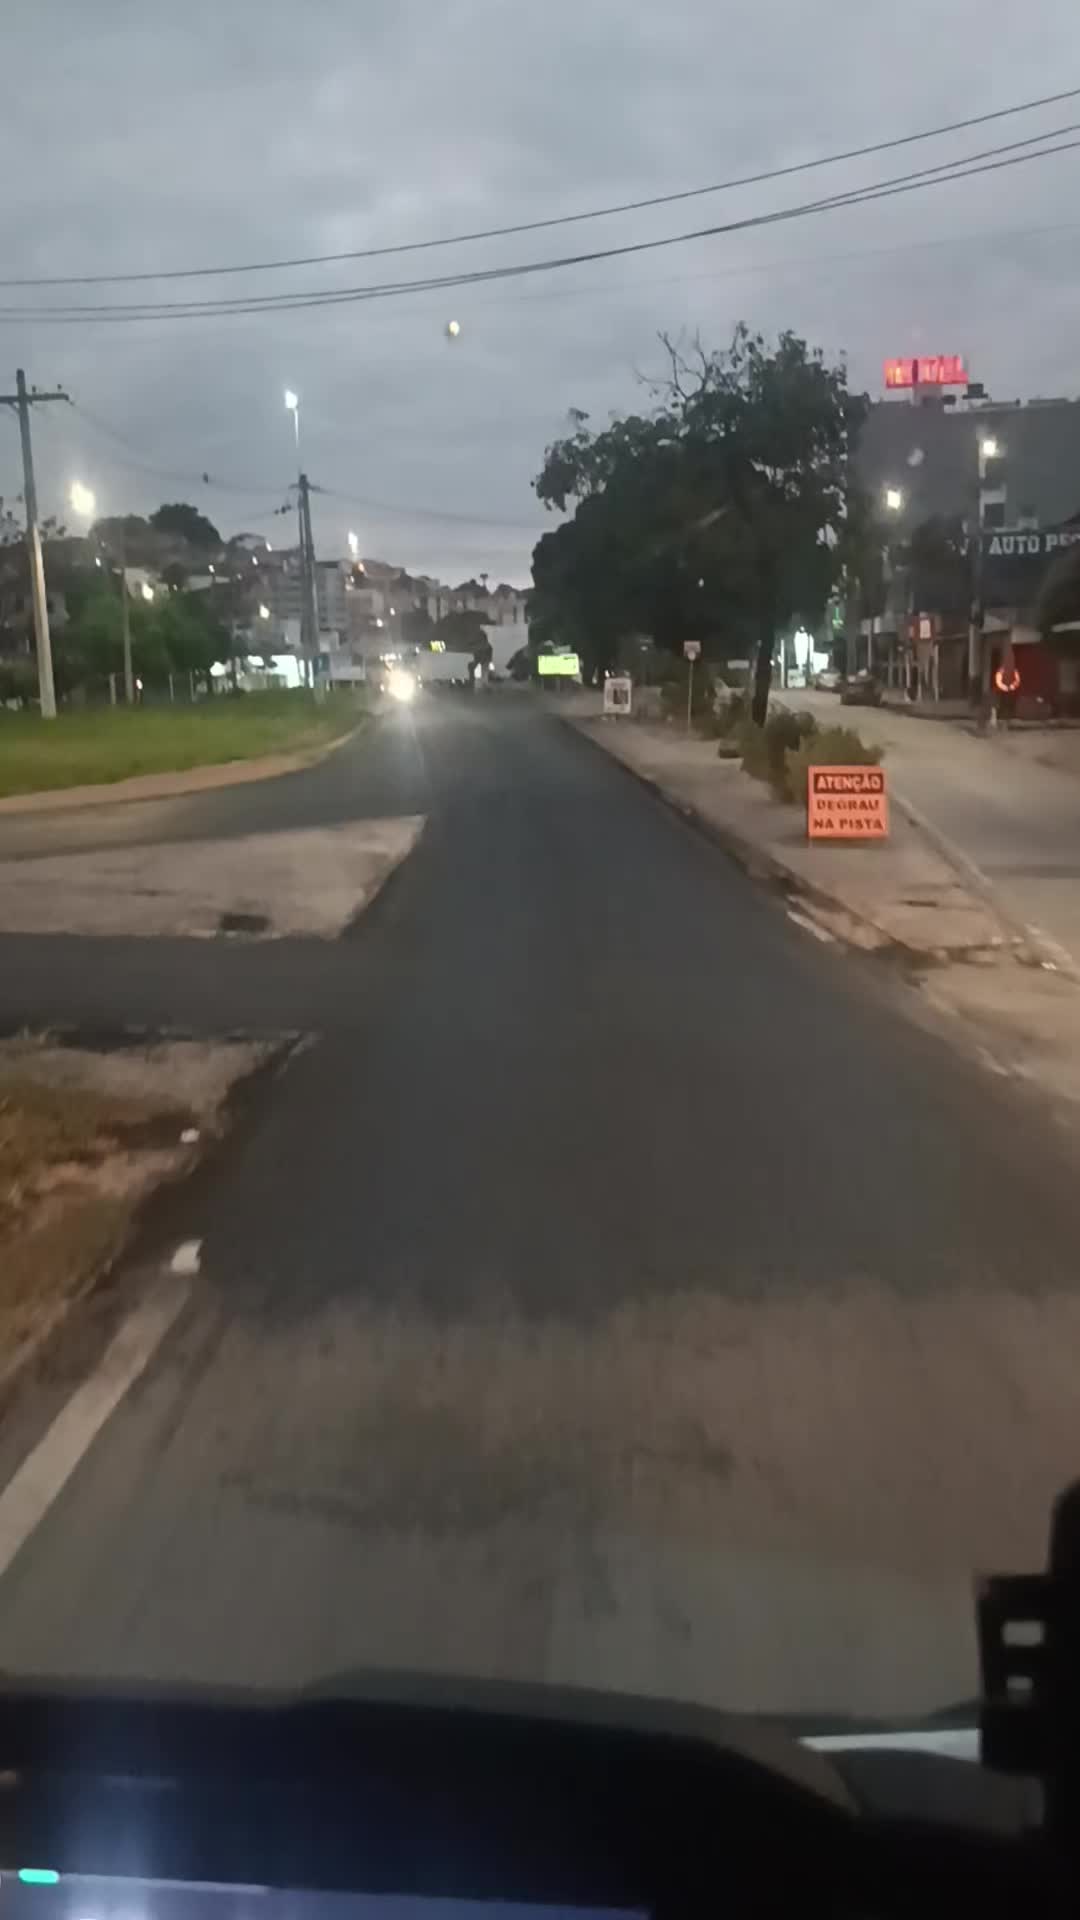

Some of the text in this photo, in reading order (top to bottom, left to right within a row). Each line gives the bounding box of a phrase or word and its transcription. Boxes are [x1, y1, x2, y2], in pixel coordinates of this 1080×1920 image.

[989, 535, 1040, 555] AUTO
[817, 775, 881, 793] ATENÇÃO
[817, 799, 879, 811] DEGRAU
[814, 818, 884, 831] NA PISTA
